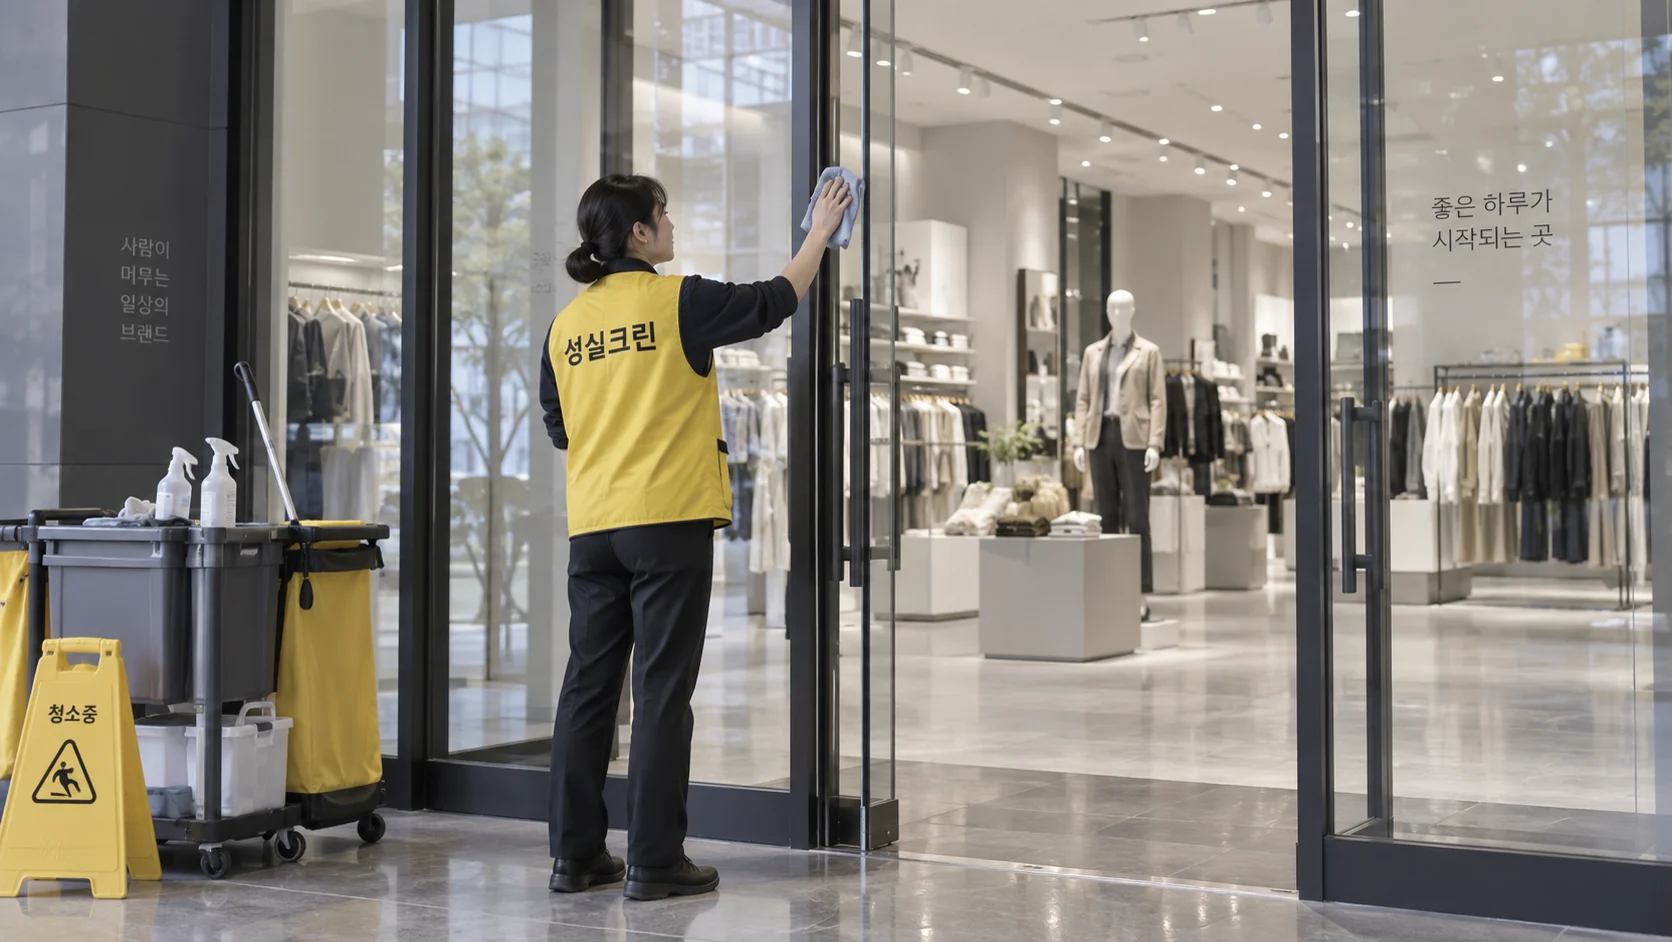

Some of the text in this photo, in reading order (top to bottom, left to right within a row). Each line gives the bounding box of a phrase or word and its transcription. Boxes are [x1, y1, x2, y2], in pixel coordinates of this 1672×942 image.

[1431, 188, 1553, 220] 좋은 하루가
[121, 236, 170, 260] 사람이
[1432, 223, 1553, 252] 시작되는 곳
[121, 265, 170, 287] 머무는
[120, 294, 169, 316] 일상의
[119, 323, 170, 344] 브랜드
[564, 321, 657, 367] 성실크린
[48, 704, 98, 725] 청소중
